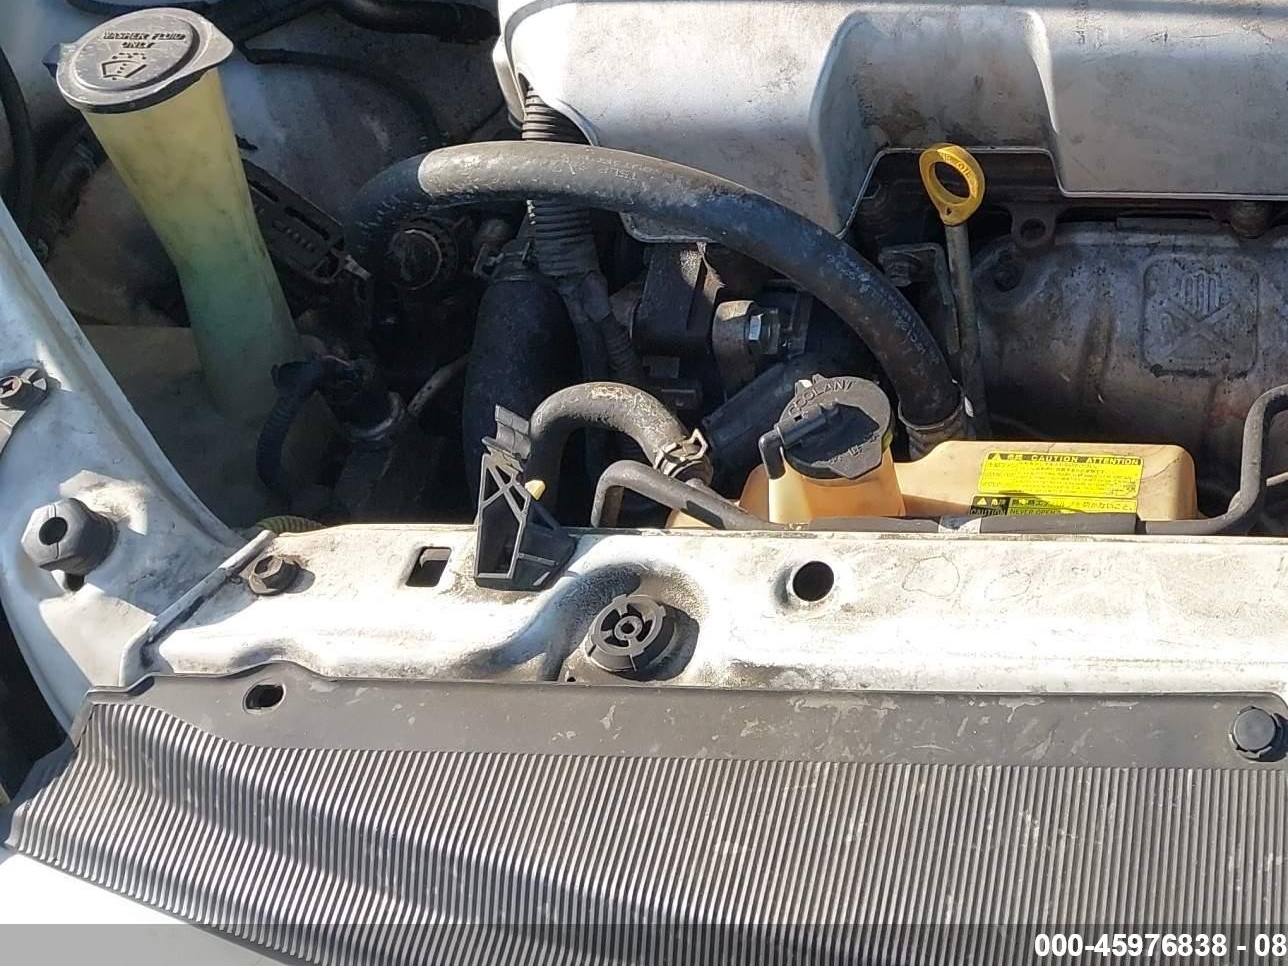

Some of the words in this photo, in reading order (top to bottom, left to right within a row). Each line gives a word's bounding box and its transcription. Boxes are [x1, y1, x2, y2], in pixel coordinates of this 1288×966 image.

[788, 380, 856, 416] COOLANT
[1031, 455, 1079, 463] CAUTION
[1085, 457, 1139, 465] ATTENTION
